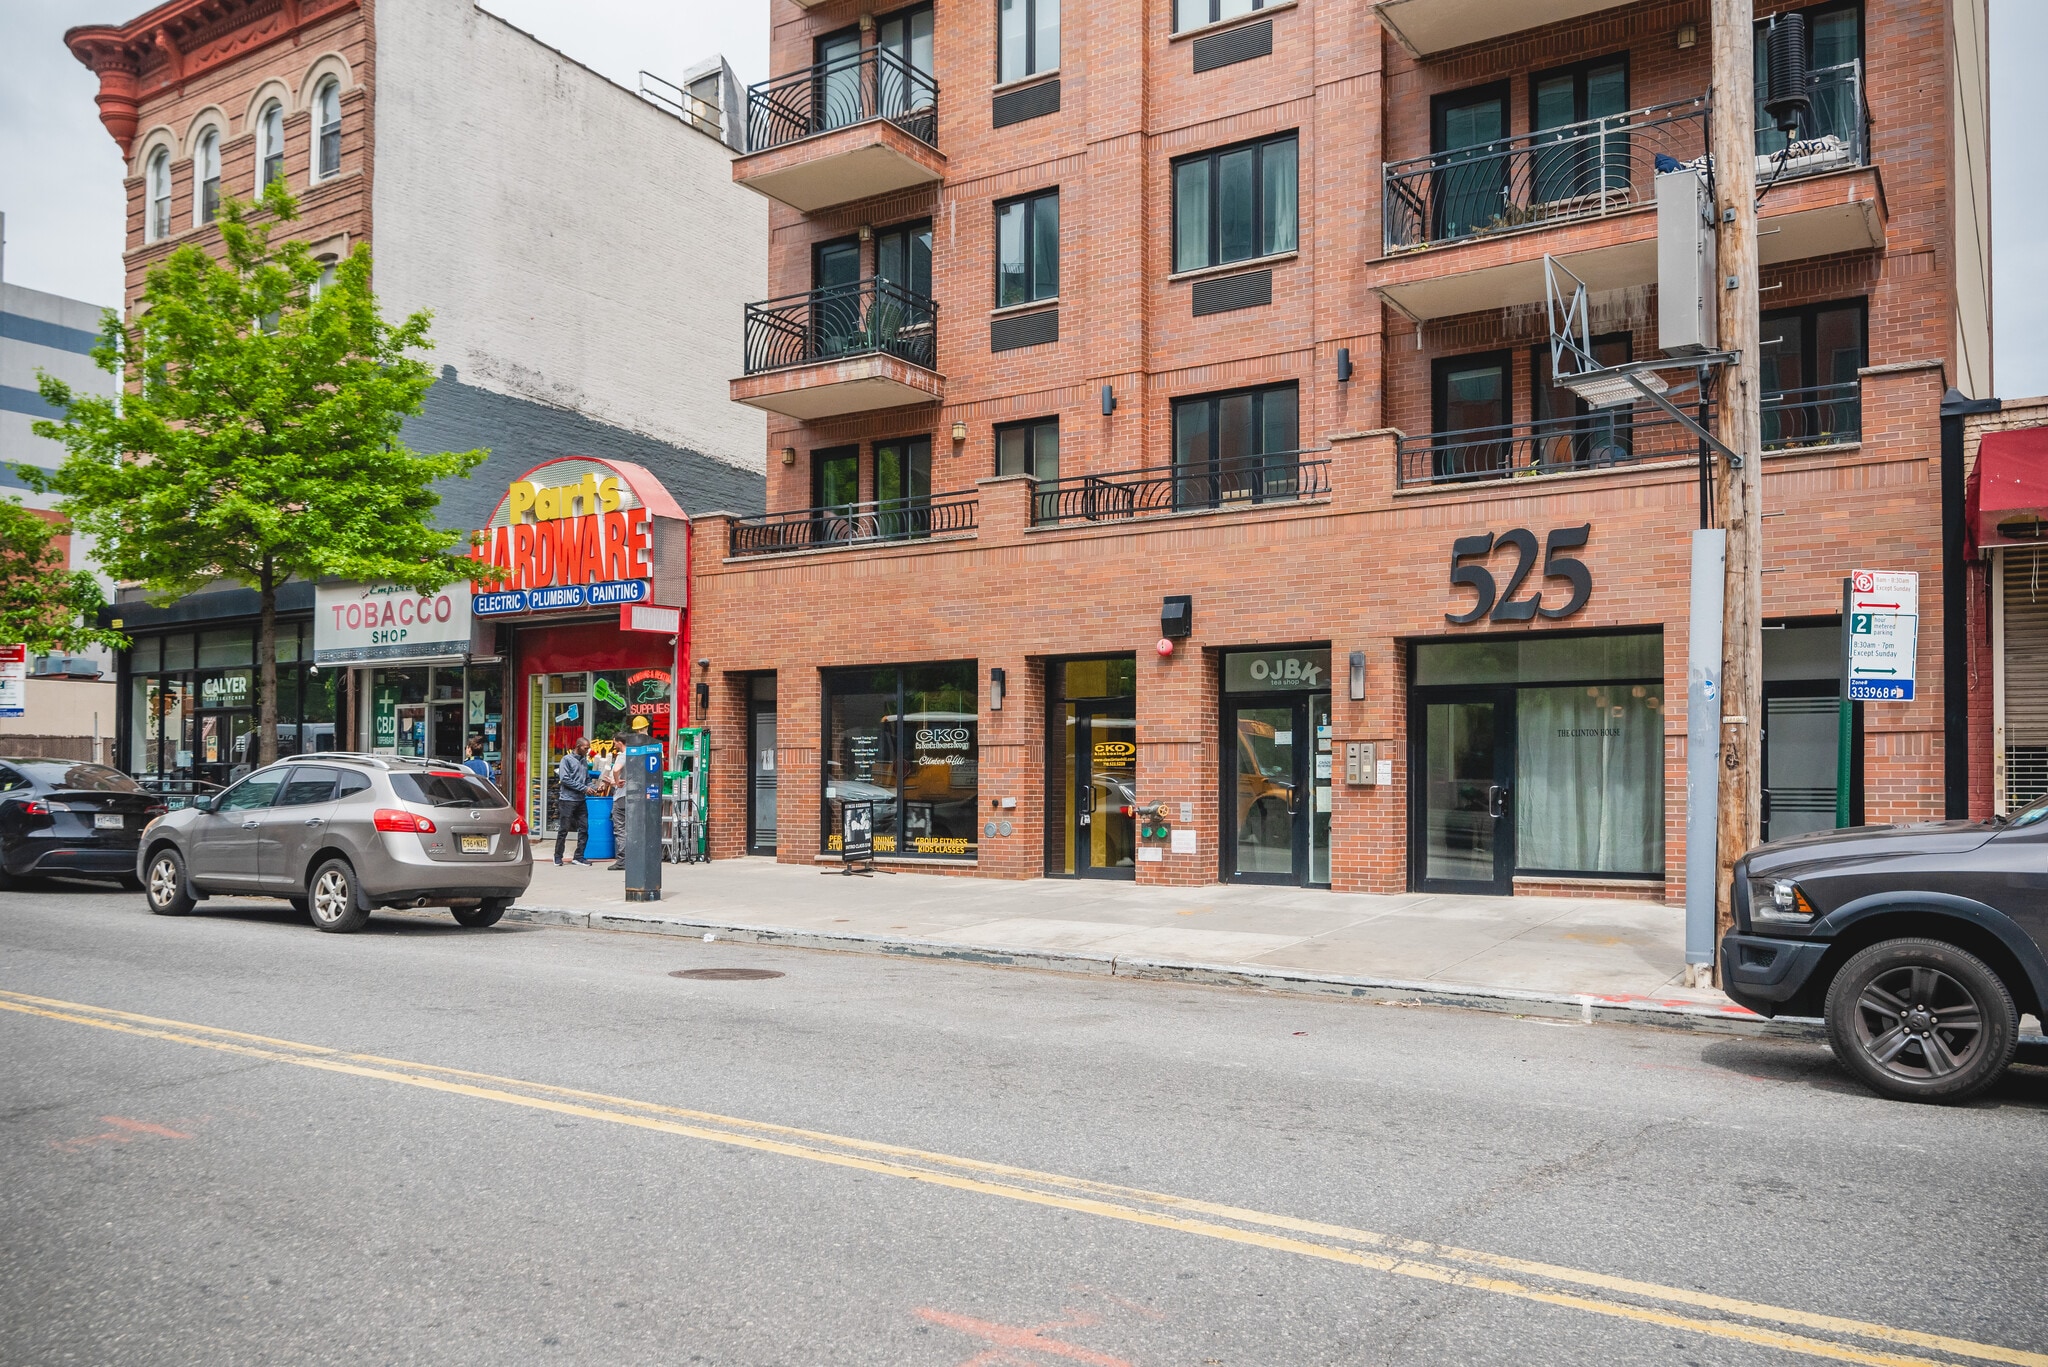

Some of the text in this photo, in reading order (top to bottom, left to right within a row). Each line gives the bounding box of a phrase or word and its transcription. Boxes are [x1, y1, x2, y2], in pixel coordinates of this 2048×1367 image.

[510, 473, 621, 525] Parts
[471, 507, 649, 594] HARDWARE
[1444, 522, 1593, 623] 525
[369, 584, 413, 596] Empire
[1876, 584, 1892, 592] Except
[479, 582, 638, 612] ELECTRIC PLUMBING PAINTING
[332, 595, 452, 631] TOBACCO
[1856, 615, 1867, 633] 2
[372, 629, 408, 644] SHOP
[1853, 641, 1876, 649] 8:30am
[1882, 641, 1895, 649] 7pm
[1853, 649, 1897, 658] Except Sunday
[1250, 658, 1323, 685] OJBK
[204, 677, 247, 695] CALYER
[1283, 678, 1300, 686] shop
[1851, 686, 1889, 698] 333968
[630, 702, 670, 715] SUPPLIES
[376, 716, 395, 734] CBD
[915, 728, 969, 742] CKO
[1557, 728, 1621, 738] THE CLINTON HOUSE
[1094, 744, 1126, 752] CKO
[918, 754, 965, 766] Clinton Hill
[915, 837, 968, 846] GROUP FITNESS
[918, 845, 965, 854] KIDS CLASSES
